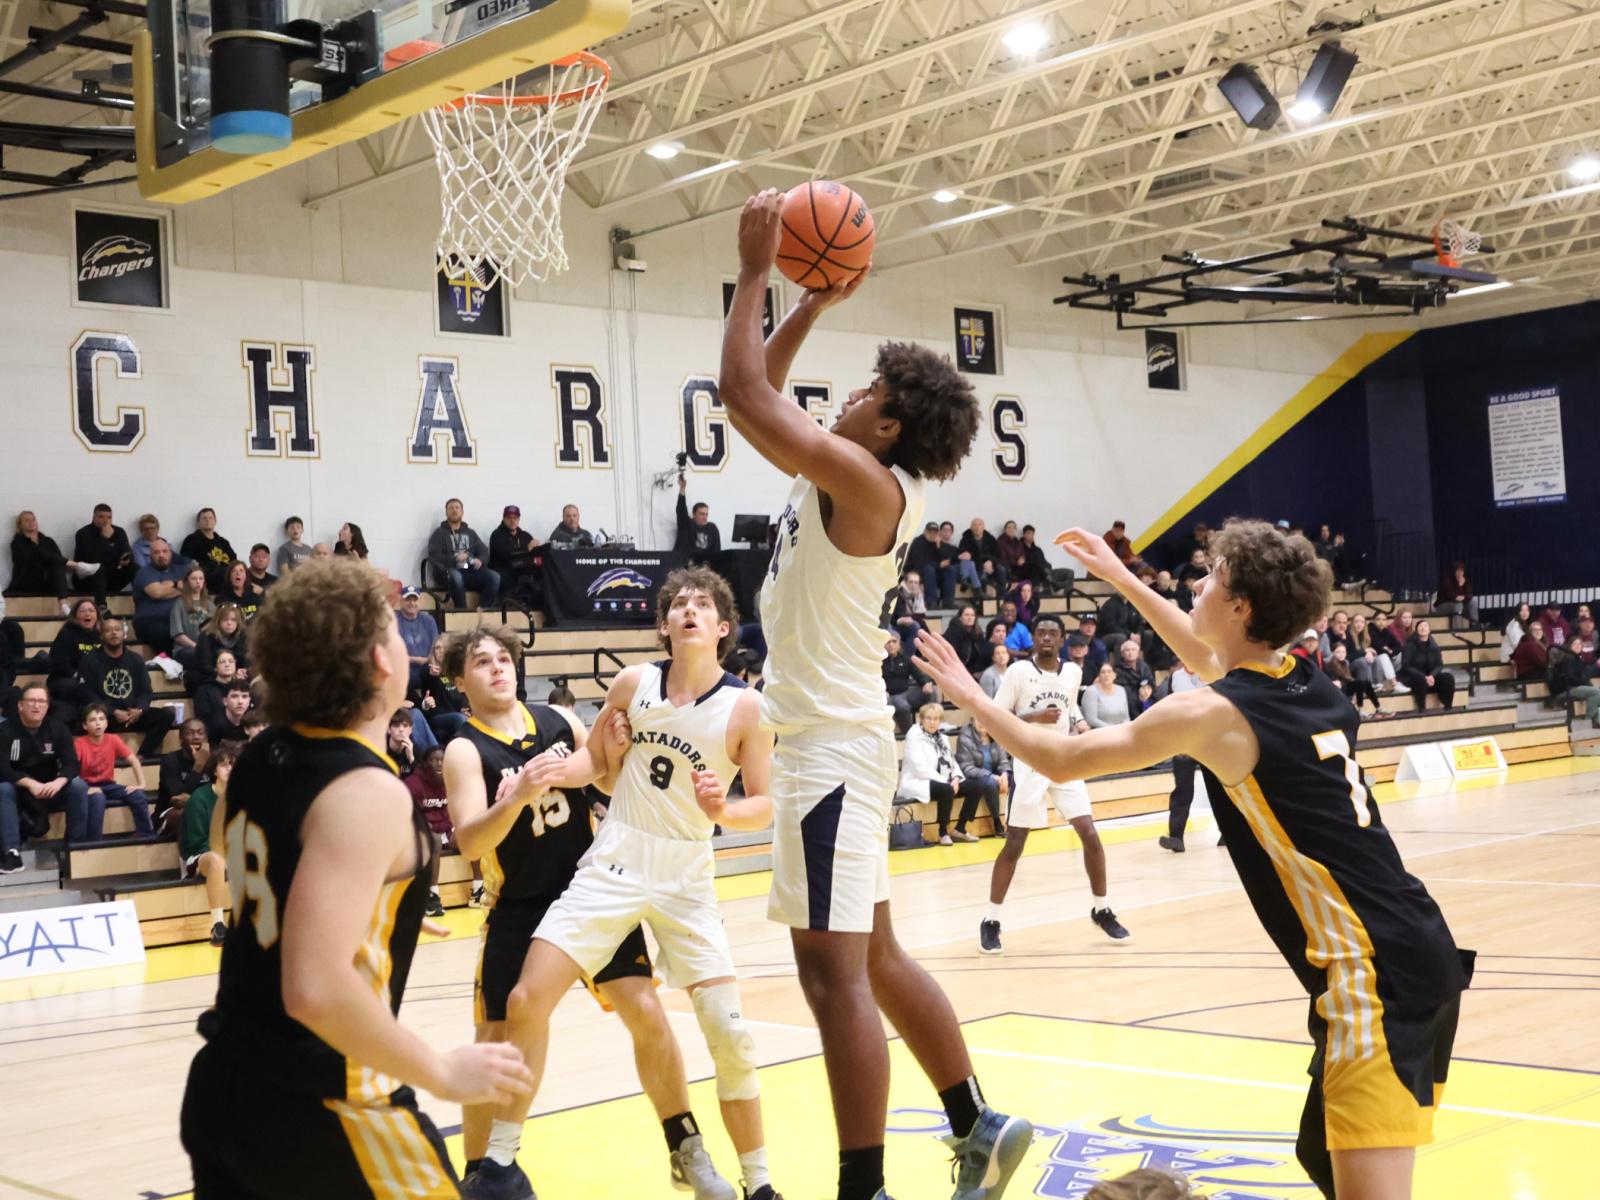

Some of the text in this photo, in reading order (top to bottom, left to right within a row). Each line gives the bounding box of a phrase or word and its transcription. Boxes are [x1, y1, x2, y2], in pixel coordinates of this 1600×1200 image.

[79, 256, 154, 282] Chargers
[1490, 396, 1499, 404] BE
[1507, 392, 1530, 401] GOOD
[1531, 388, 1556, 398] SPORT
[1029, 691, 1069, 709] MATADOR
[649, 755, 674, 790] 9
[1310, 729, 1372, 829] 7
[530, 789, 571, 838] 15
